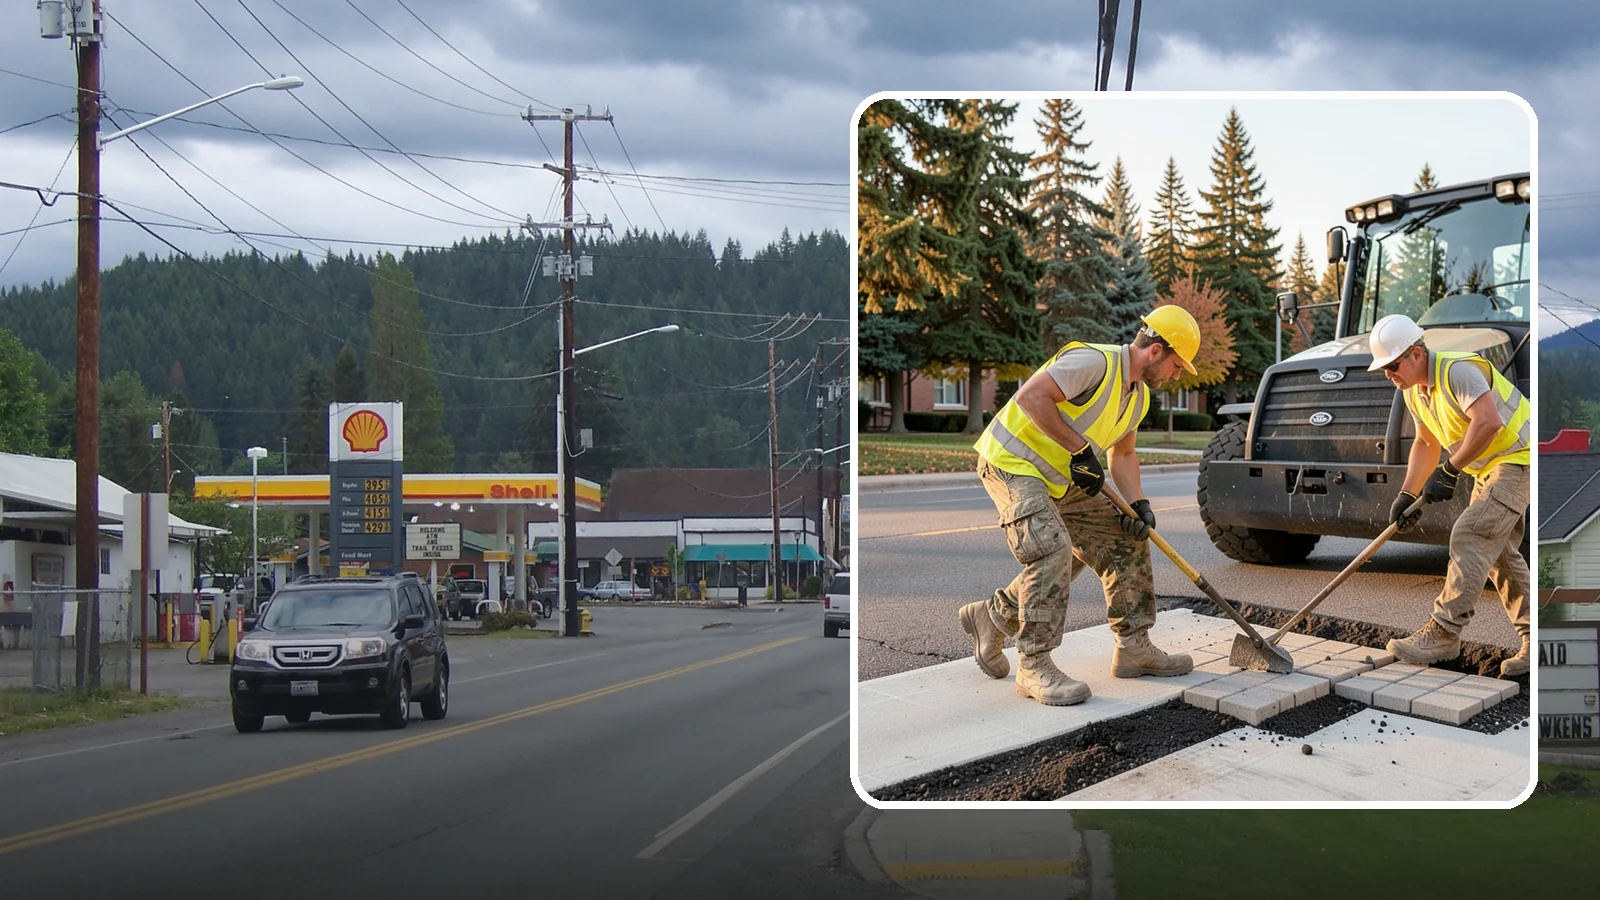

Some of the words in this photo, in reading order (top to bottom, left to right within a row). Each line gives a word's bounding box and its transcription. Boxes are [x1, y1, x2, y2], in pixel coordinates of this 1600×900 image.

[365, 480, 383, 490] 395
[490, 484, 547, 499] Shell
[365, 494, 383, 504] 405
[365, 508, 383, 518] 415
[365, 522, 383, 533] 429
